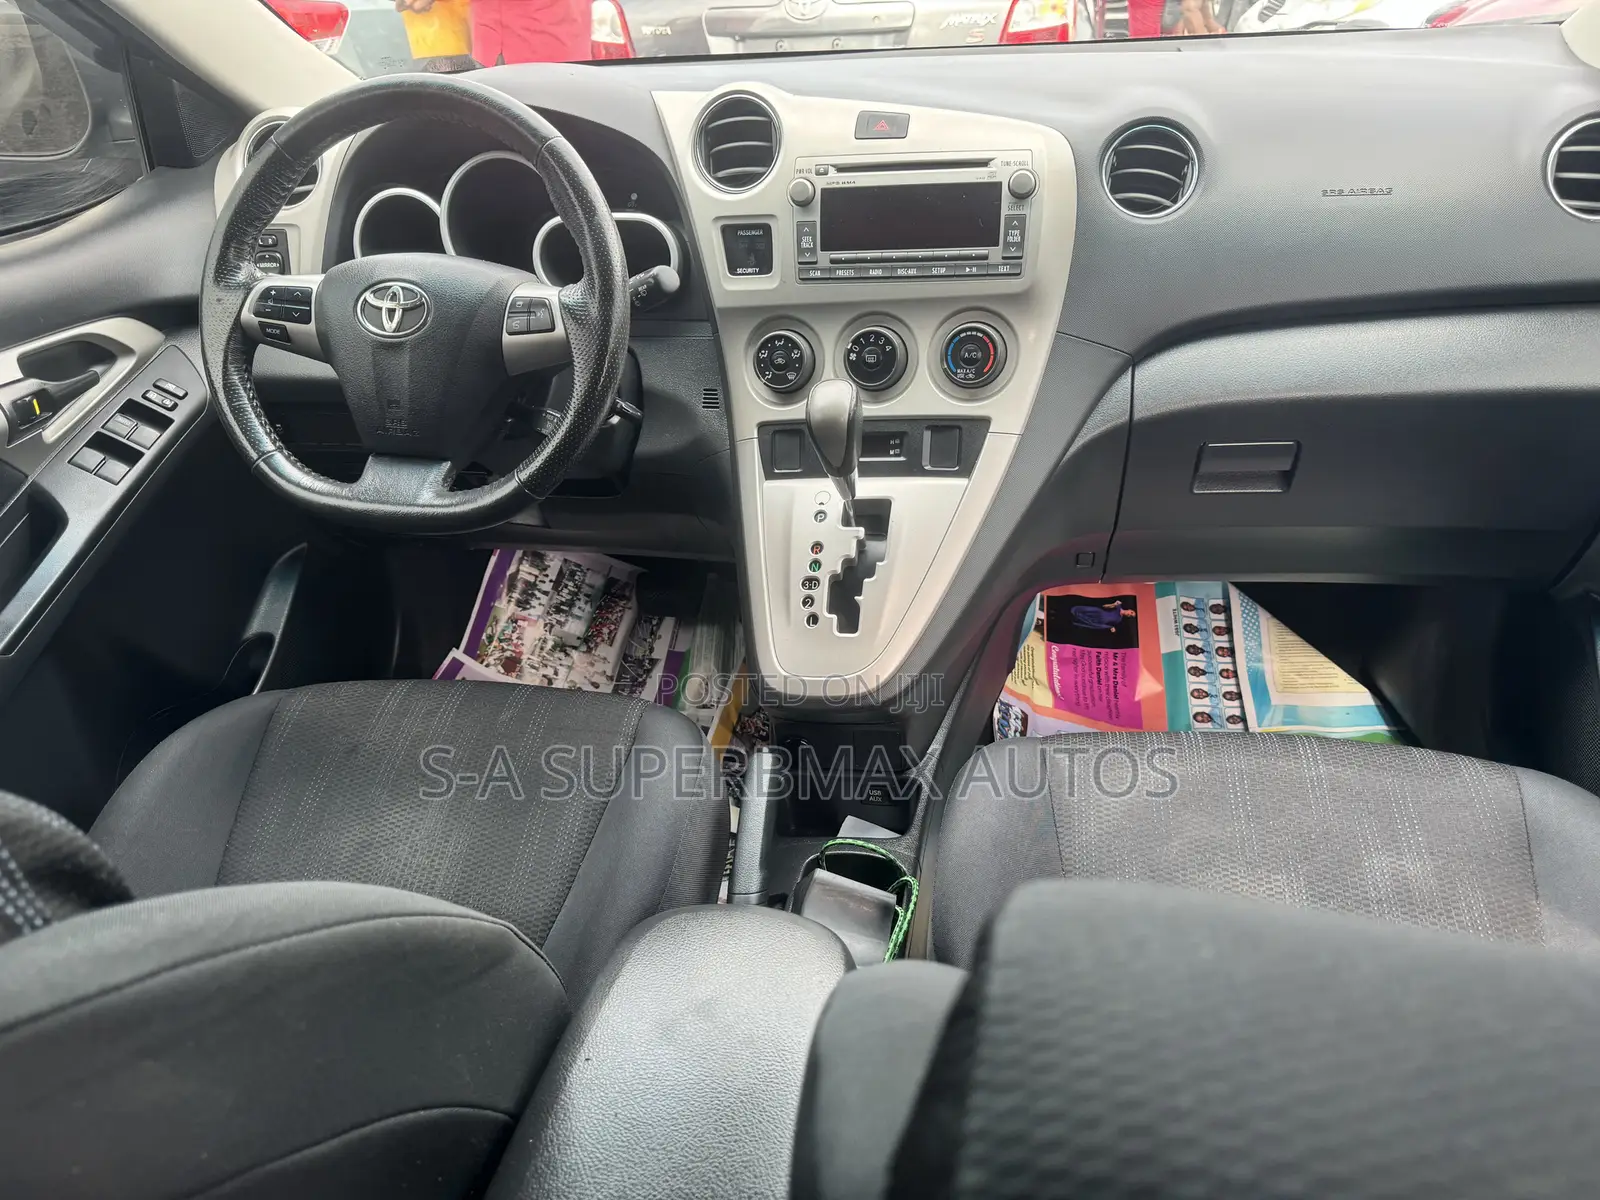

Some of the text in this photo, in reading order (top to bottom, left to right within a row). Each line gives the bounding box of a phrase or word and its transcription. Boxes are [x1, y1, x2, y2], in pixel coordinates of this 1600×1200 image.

[869, 333, 875, 342] 2
[878, 336, 886, 345] 3
[816, 512, 825, 520] P
[813, 546, 820, 555] R
[804, 598, 812, 609] 2
